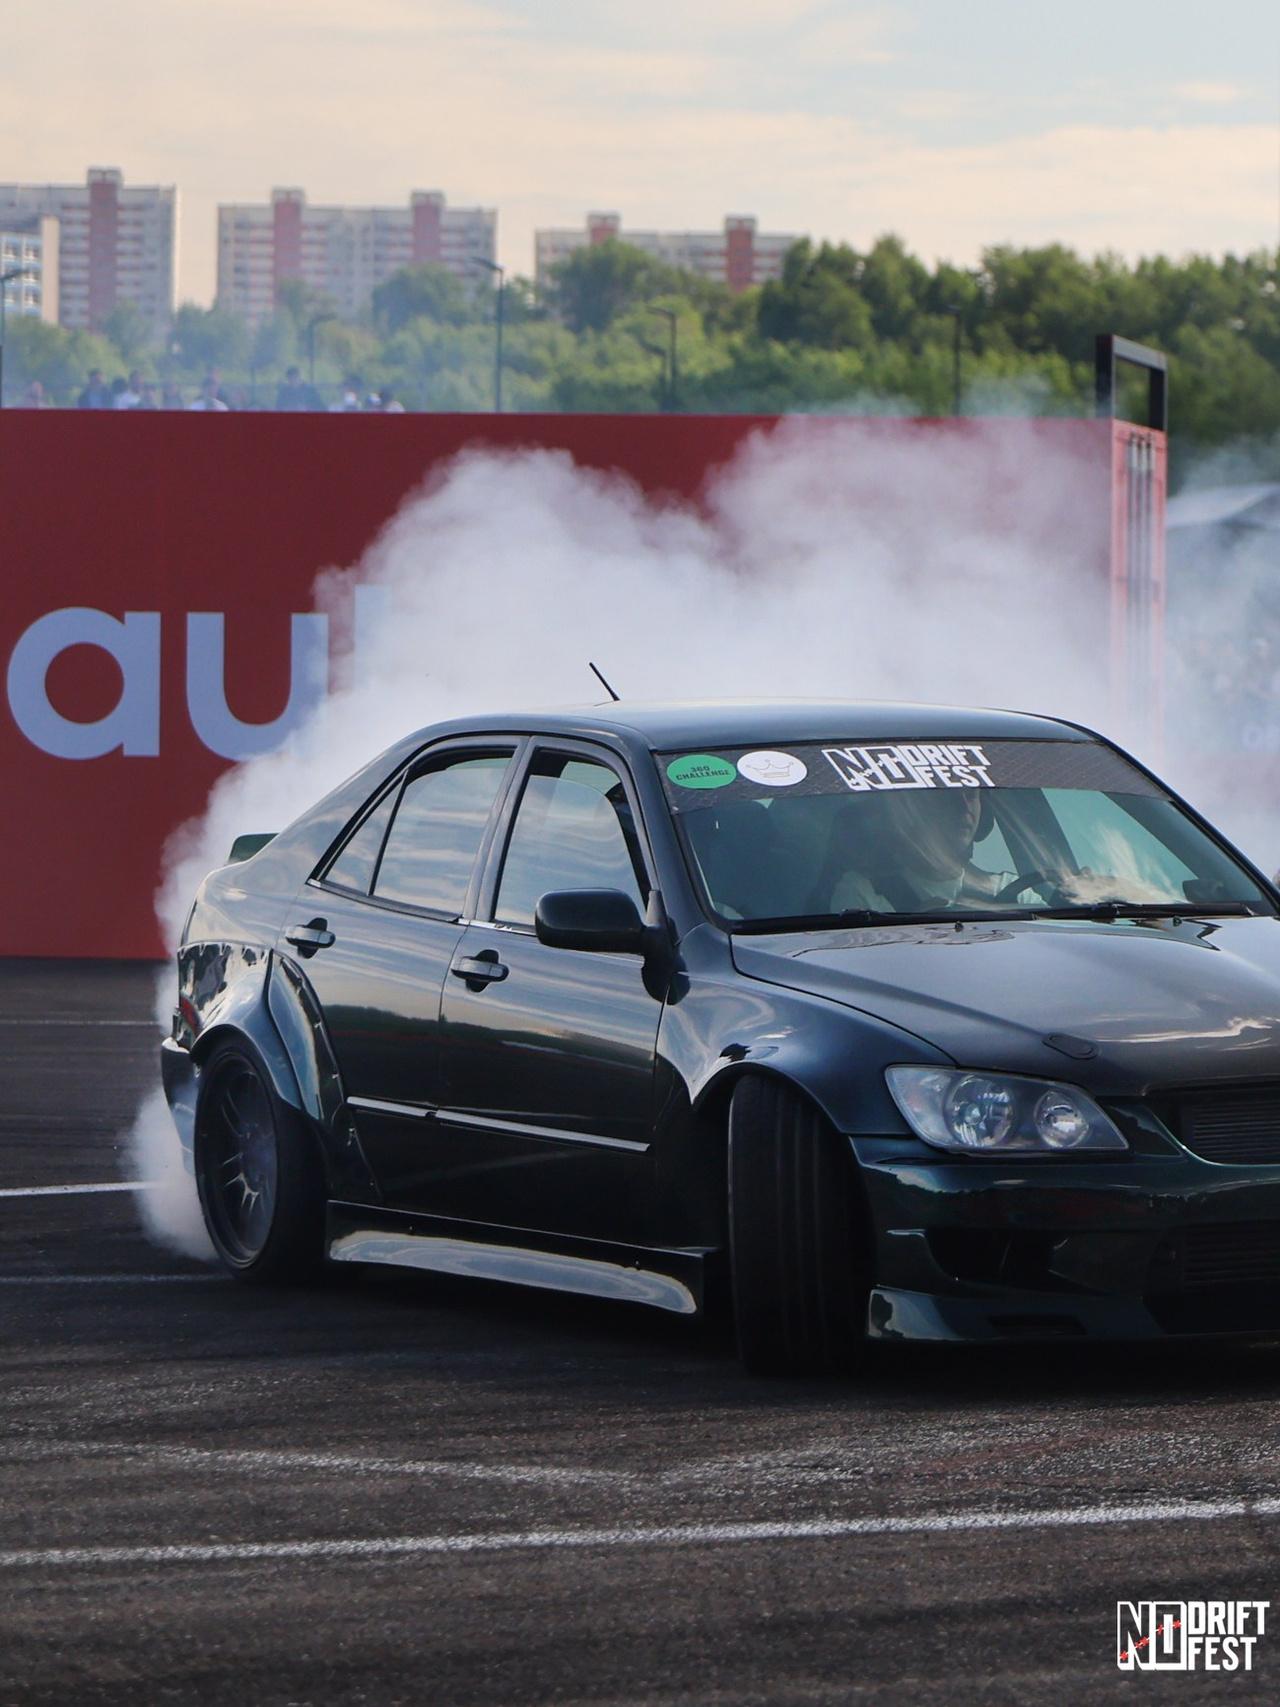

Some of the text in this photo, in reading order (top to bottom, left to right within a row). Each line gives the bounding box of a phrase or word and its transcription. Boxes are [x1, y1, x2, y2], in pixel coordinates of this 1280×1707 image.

[897, 745, 991, 766] DRIFT
[676, 769, 731, 781] CHALLENGE
[914, 766, 996, 788] FEST
